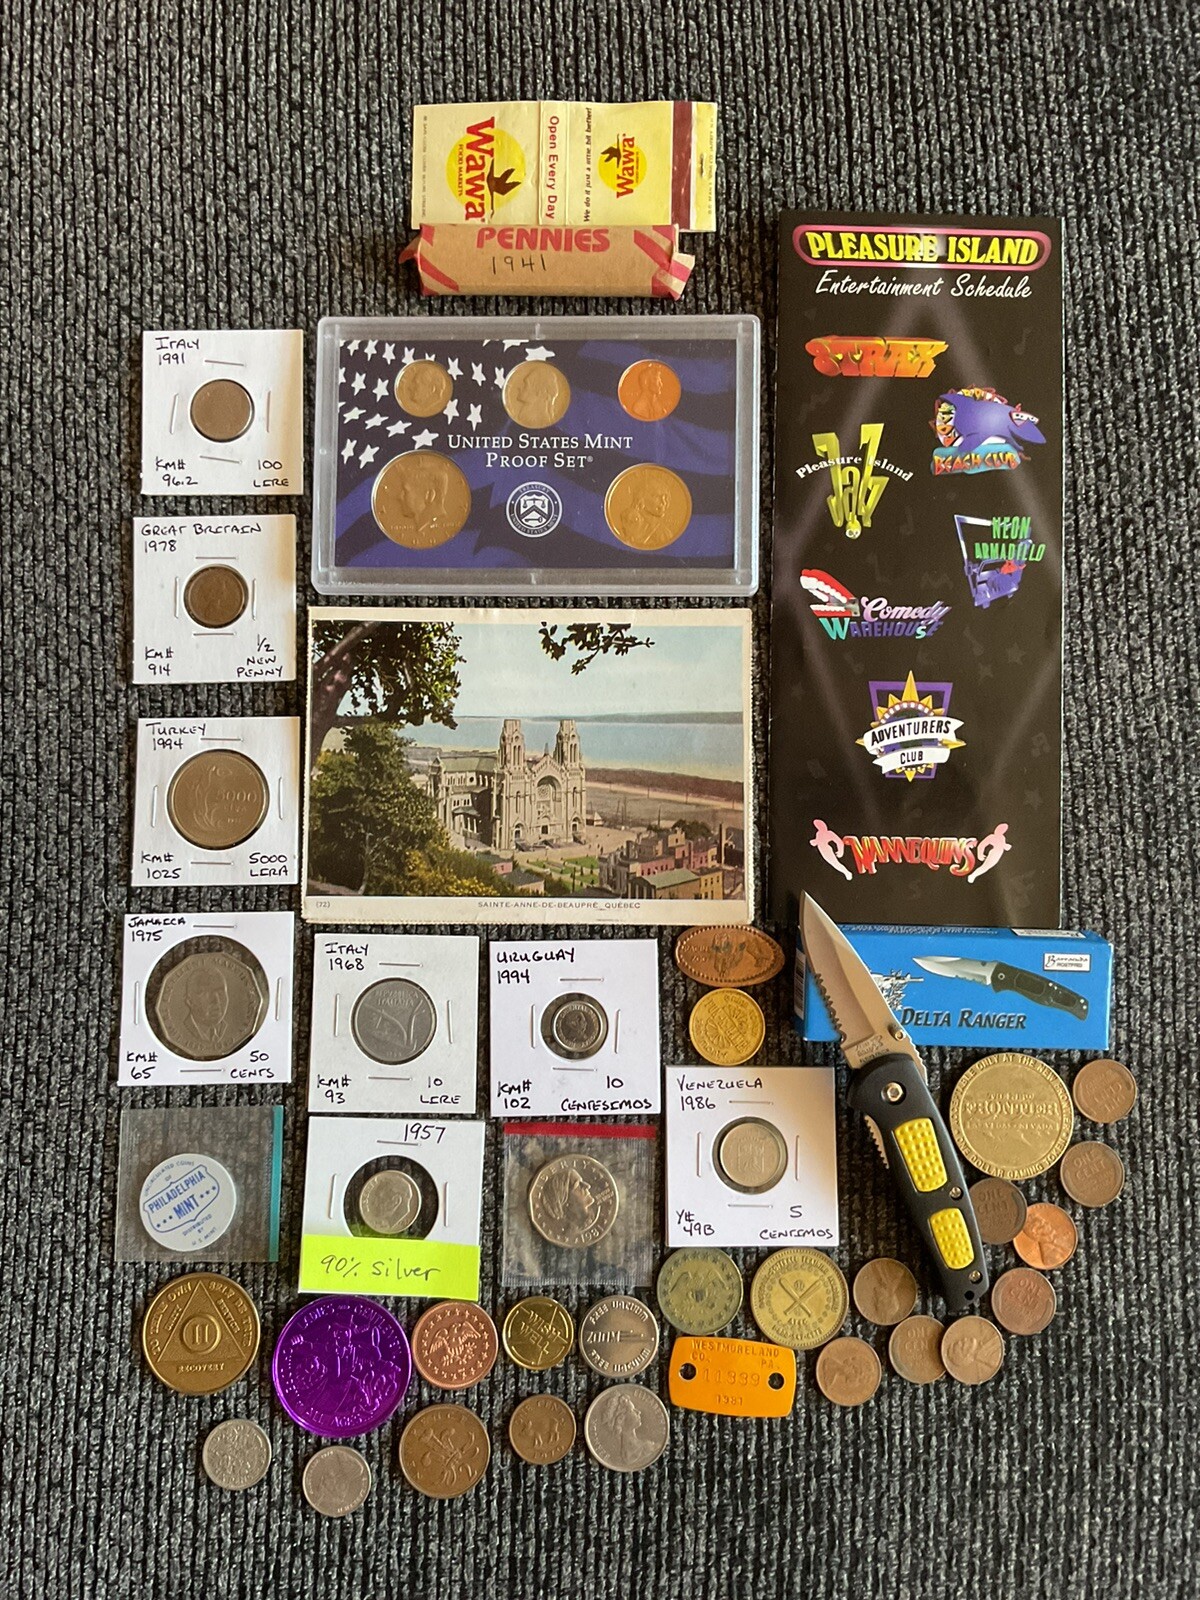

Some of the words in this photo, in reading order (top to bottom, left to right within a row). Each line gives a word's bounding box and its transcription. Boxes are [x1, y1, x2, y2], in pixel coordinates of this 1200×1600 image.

[547, 115, 559, 149] Open
[585, 135, 593, 146] bit
[464, 116, 495, 221] Wawa
[546, 154, 559, 190] Every
[616, 136, 635, 199] Wawa
[585, 175, 593, 188] just
[545, 195, 558, 219] Day
[583, 197, 592, 208] do
[583, 209, 592, 222] We
[476, 227, 611, 252] PENNIES
[804, 231, 940, 262] PLEASURE
[946, 236, 1039, 265] ISLAND
[492, 254, 547, 275] 1941
[815, 269, 944, 296] Entertainment
[950, 272, 1032, 298] Schedule
[155, 337, 200, 351] ITALY
[158, 353, 185, 366] 1991
[448, 434, 513, 450] UNITED
[518, 434, 580, 450] STATES
[584, 434, 633, 450] MINT
[155, 456, 187, 471] KM#
[258, 460, 283, 470] 100
[486, 452, 549, 468] PROOF
[795, 456, 862, 479] Pleasure
[934, 453, 981, 475] BEACH
[984, 452, 1018, 470] CLUB
[162, 474, 198, 486] 96.2
[141, 524, 187, 536] GREAT
[991, 516, 1031, 539] NEON
[144, 540, 177, 553] 1978
[974, 543, 1046, 562] ARMADILLO
[860, 596, 952, 625] Comedy
[818, 617, 944, 640] WAREHOUSE
[145, 646, 174, 660] KM#
[246, 655, 277, 666] NEW
[148, 664, 171, 676] 914
[237, 665, 284, 678] PENNY
[145, 722, 206, 736] TURKEY
[870, 719, 952, 746] ADVENTURERS
[153, 738, 184, 751] 1994
[899, 751, 924, 765] CLUB
[249, 852, 288, 864] 5000
[843, 835, 978, 877] MANNEQUINS
[146, 868, 182, 880] 1025
[315, 901, 331, 909] (72)
[131, 930, 164, 942] 1975
[325, 942, 369, 956] ITALY
[496, 947, 575, 964] URUGUAY
[329, 958, 365, 971] 1968
[497, 969, 531, 984] 1994
[900, 1007, 951, 1027] DELTA
[957, 1008, 1027, 1029] RANGER
[249, 1051, 270, 1062] 50
[130, 1067, 156, 1079] 65
[230, 1067, 275, 1079] CENTS
[976, 1055, 1000, 1072] ONLY
[1002, 1053, 1015, 1063] AT
[1018, 1054, 1037, 1068] THE
[1036, 1063, 1058, 1083] NEW
[427, 1076, 443, 1088] 10
[606, 1076, 624, 1089] 10
[676, 1075, 763, 1091] VENEZUELA
[325, 1090, 346, 1104] 93
[504, 1097, 531, 1110] 102
[680, 1096, 716, 1111] 1986
[403, 1123, 446, 1144] 1957
[956, 1136, 970, 1156] ONE
[970, 1154, 1005, 1178] DOLLAR
[1006, 1162, 1044, 1179] GAMING
[1045, 1138, 1067, 1166] TOKEN
[148, 1170, 206, 1214] PHILADELPHIA
[173, 1193, 199, 1220] MINT
[683, 1222, 715, 1237] 49B
[320, 1254, 361, 1278] 90%
[528, 1309, 563, 1341] WISH
[520, 1321, 550, 1355] WELL
[691, 1339, 779, 1357] WESTMORELAND
